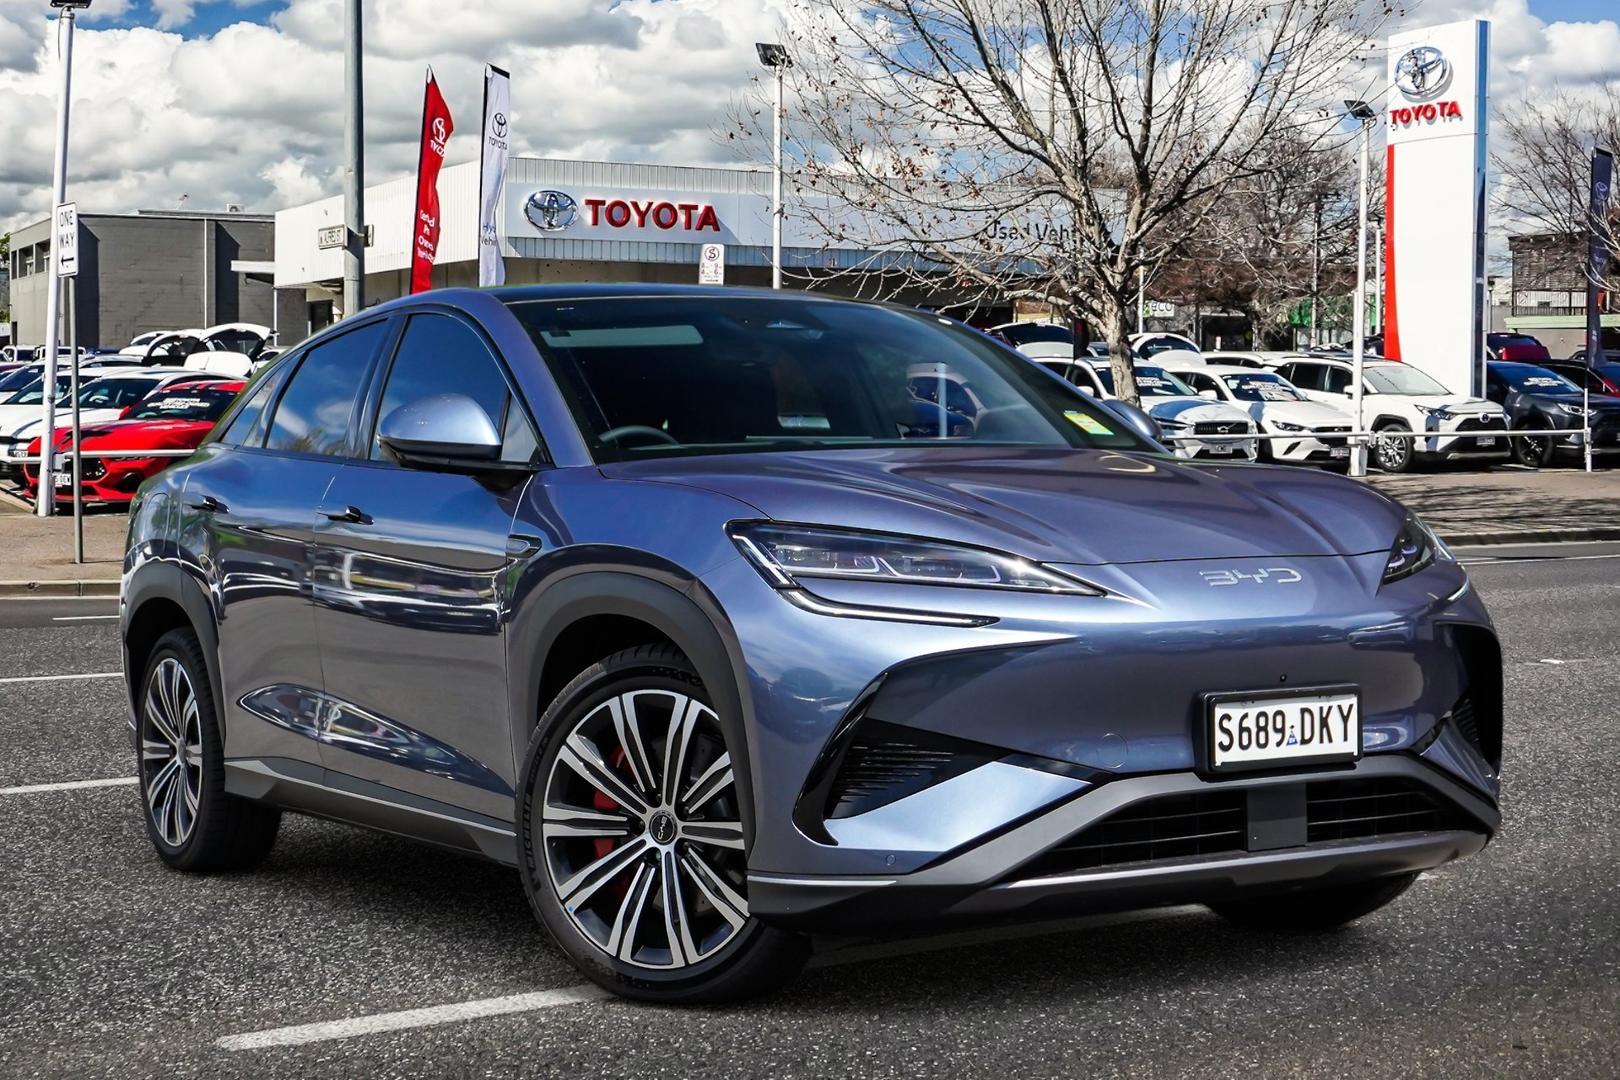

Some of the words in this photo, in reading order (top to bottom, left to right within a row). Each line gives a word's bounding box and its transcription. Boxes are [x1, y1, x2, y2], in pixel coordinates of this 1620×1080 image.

[1389, 100, 1462, 125] TOYOTA
[60, 210, 74, 227] ONE
[584, 199, 721, 232] TOYOTA
[59, 232, 75, 249] WAY
[985, 222, 1029, 240] Used
[1199, 567, 1302, 587] BYD
[1217, 709, 1286, 753] S689
[1299, 703, 1355, 746] DKY
